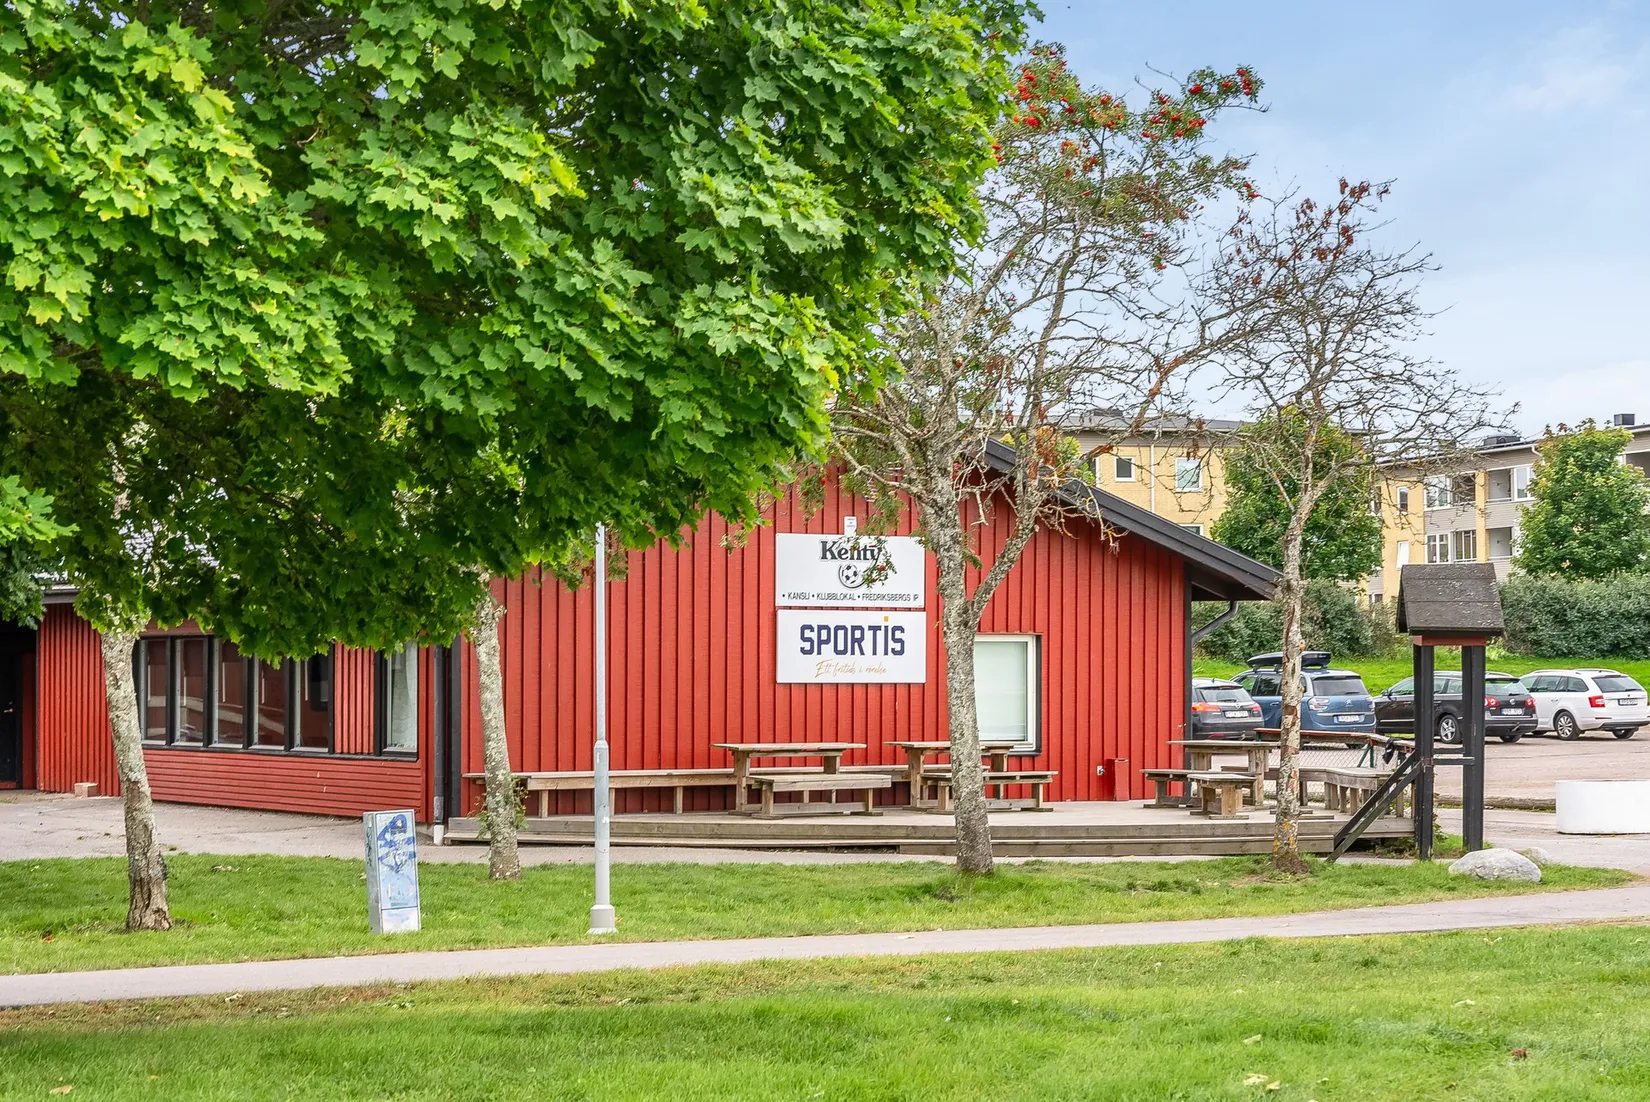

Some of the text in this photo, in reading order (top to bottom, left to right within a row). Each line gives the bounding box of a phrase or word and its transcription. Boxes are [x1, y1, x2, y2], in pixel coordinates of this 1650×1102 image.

[821, 540, 881, 565] Kenty
[787, 592, 810, 601] KANSLI
[816, 592, 856, 601] KLUBBLOKAL
[862, 593, 911, 602] FREDRIKSBERGS
[815, 659, 832, 678] Ett
